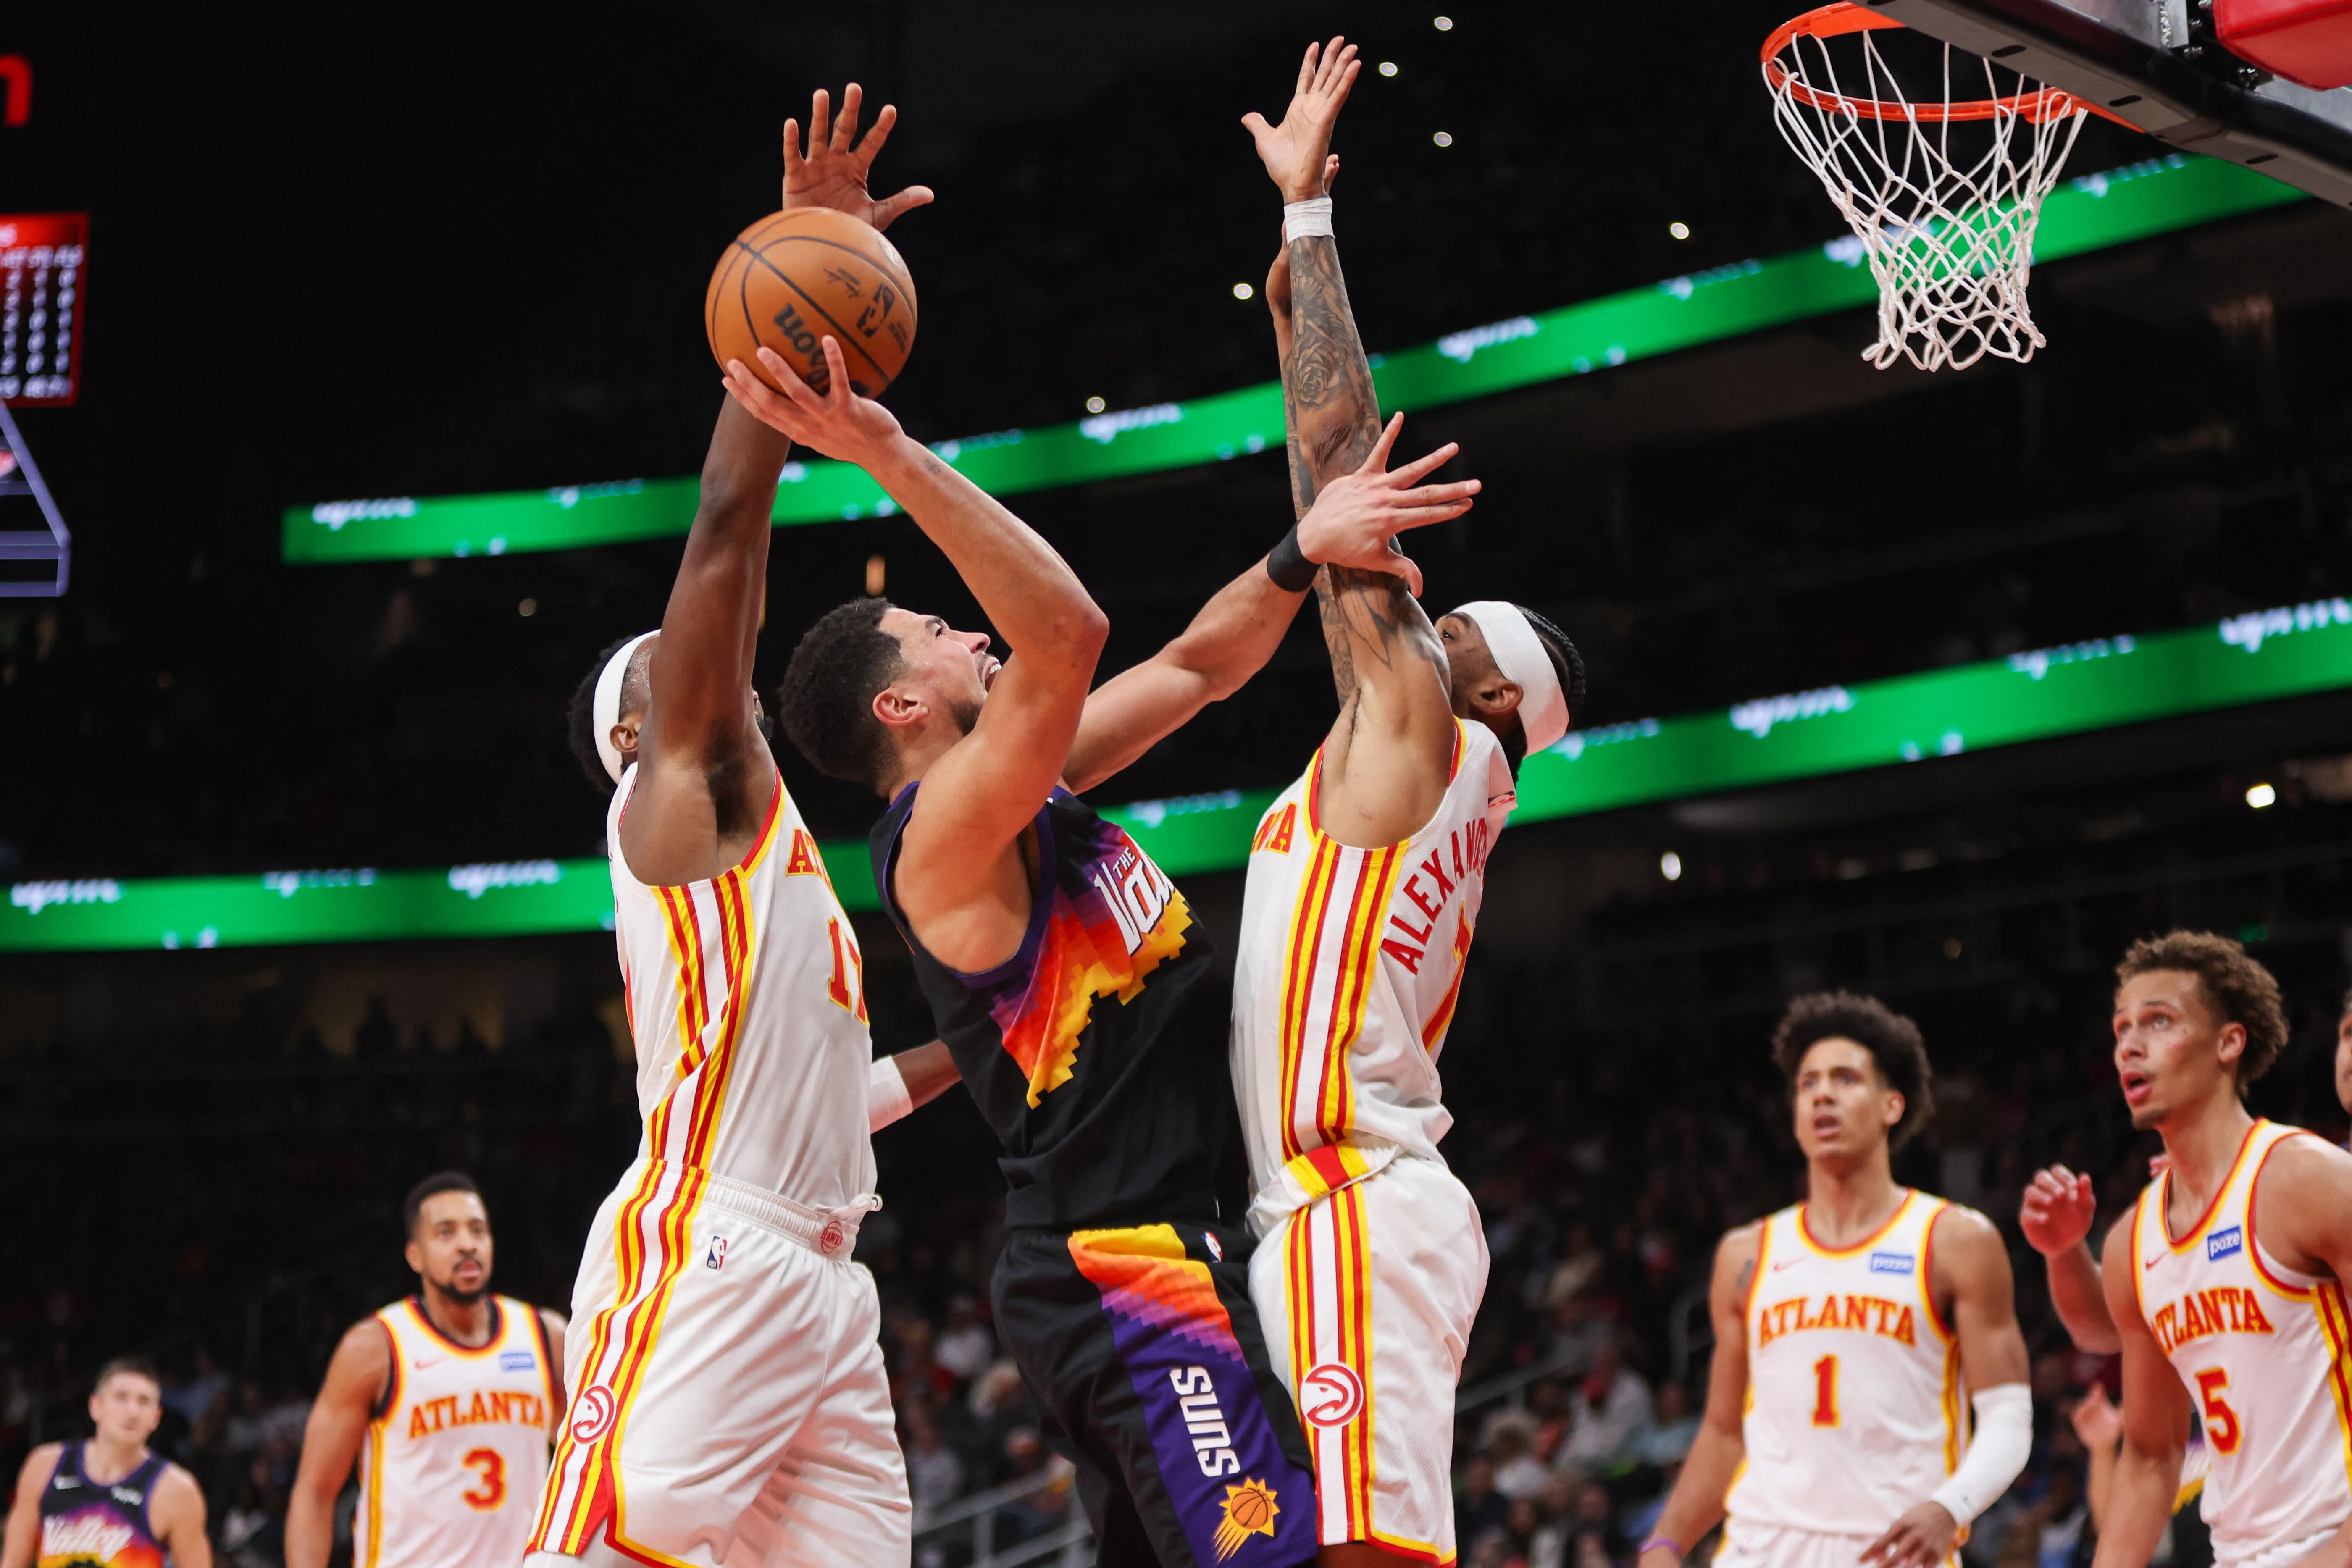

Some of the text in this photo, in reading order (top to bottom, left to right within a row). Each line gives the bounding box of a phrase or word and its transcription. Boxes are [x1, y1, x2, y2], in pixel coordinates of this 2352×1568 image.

[1113, 846, 1136, 880] THE
[708, 1260, 717, 1268] NBA
[2210, 1232, 2240, 1258] paze
[1758, 1294, 1917, 1349] ATLANTA
[408, 1391, 545, 1440] ATLANTA
[1811, 1353, 1841, 1429] 1
[2194, 1366, 2243, 1457] 5
[1169, 1366, 1241, 1478] SUNS
[462, 1447, 507, 1513] 3
